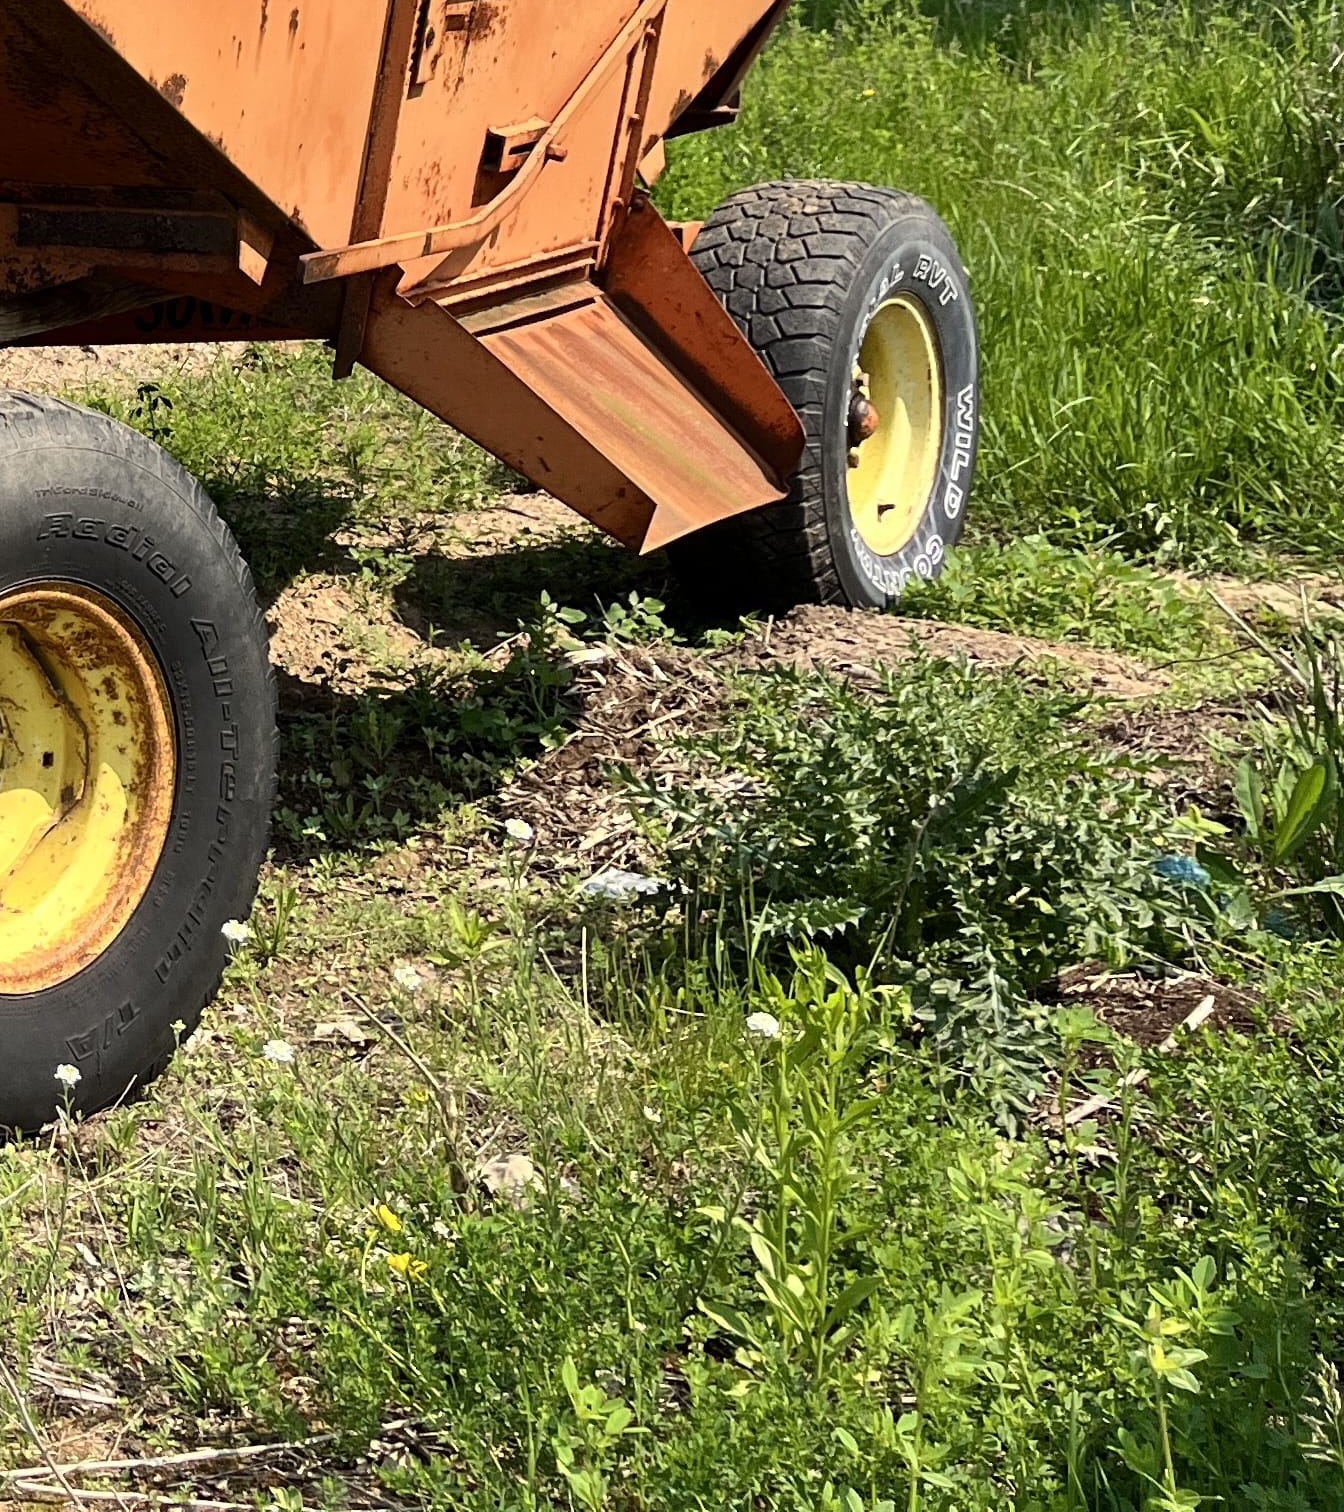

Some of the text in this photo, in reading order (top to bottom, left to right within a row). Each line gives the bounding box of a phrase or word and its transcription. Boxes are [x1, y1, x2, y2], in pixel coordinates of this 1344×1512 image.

[913, 254, 959, 306] RVT
[943, 383, 975, 520] WILD
[36, 511, 193, 599] Radial
[65, 999, 142, 1062] T/A
